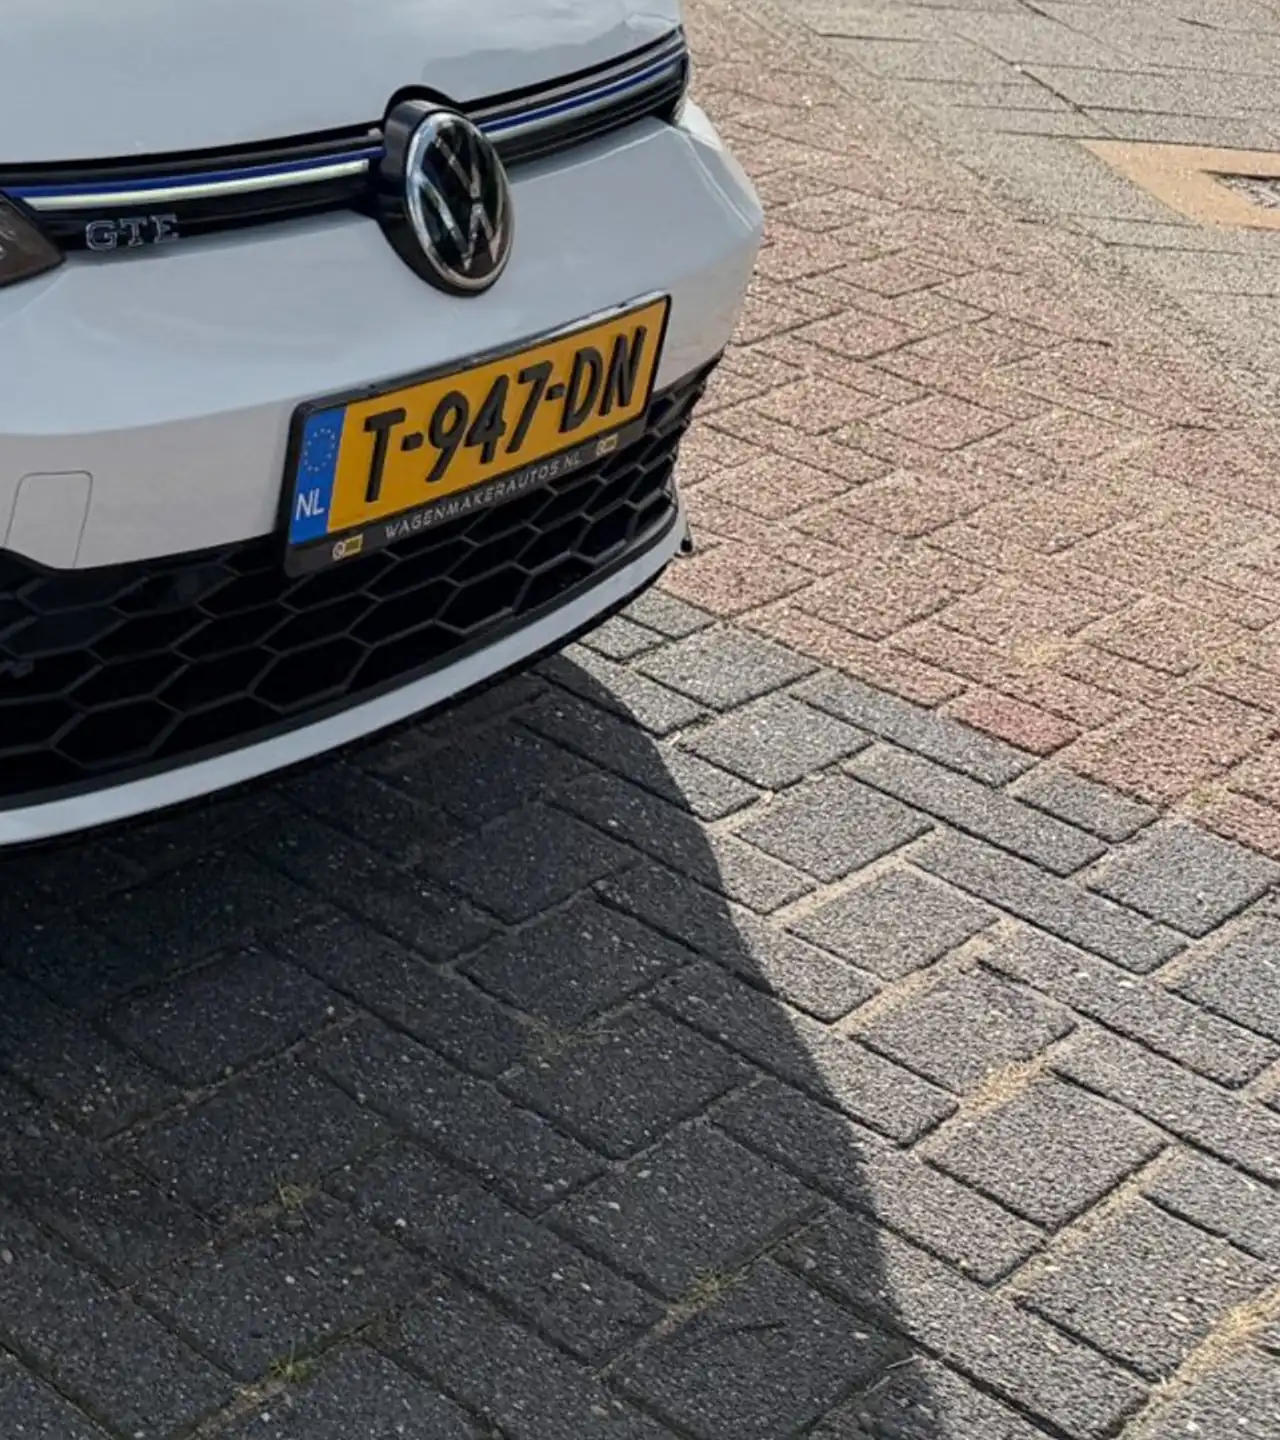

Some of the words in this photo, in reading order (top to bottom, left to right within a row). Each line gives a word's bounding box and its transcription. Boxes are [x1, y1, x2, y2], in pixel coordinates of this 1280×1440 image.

[85, 212, 180, 252] GTE
[295, 487, 325, 521] NL
[363, 325, 648, 503] T-947-DN
